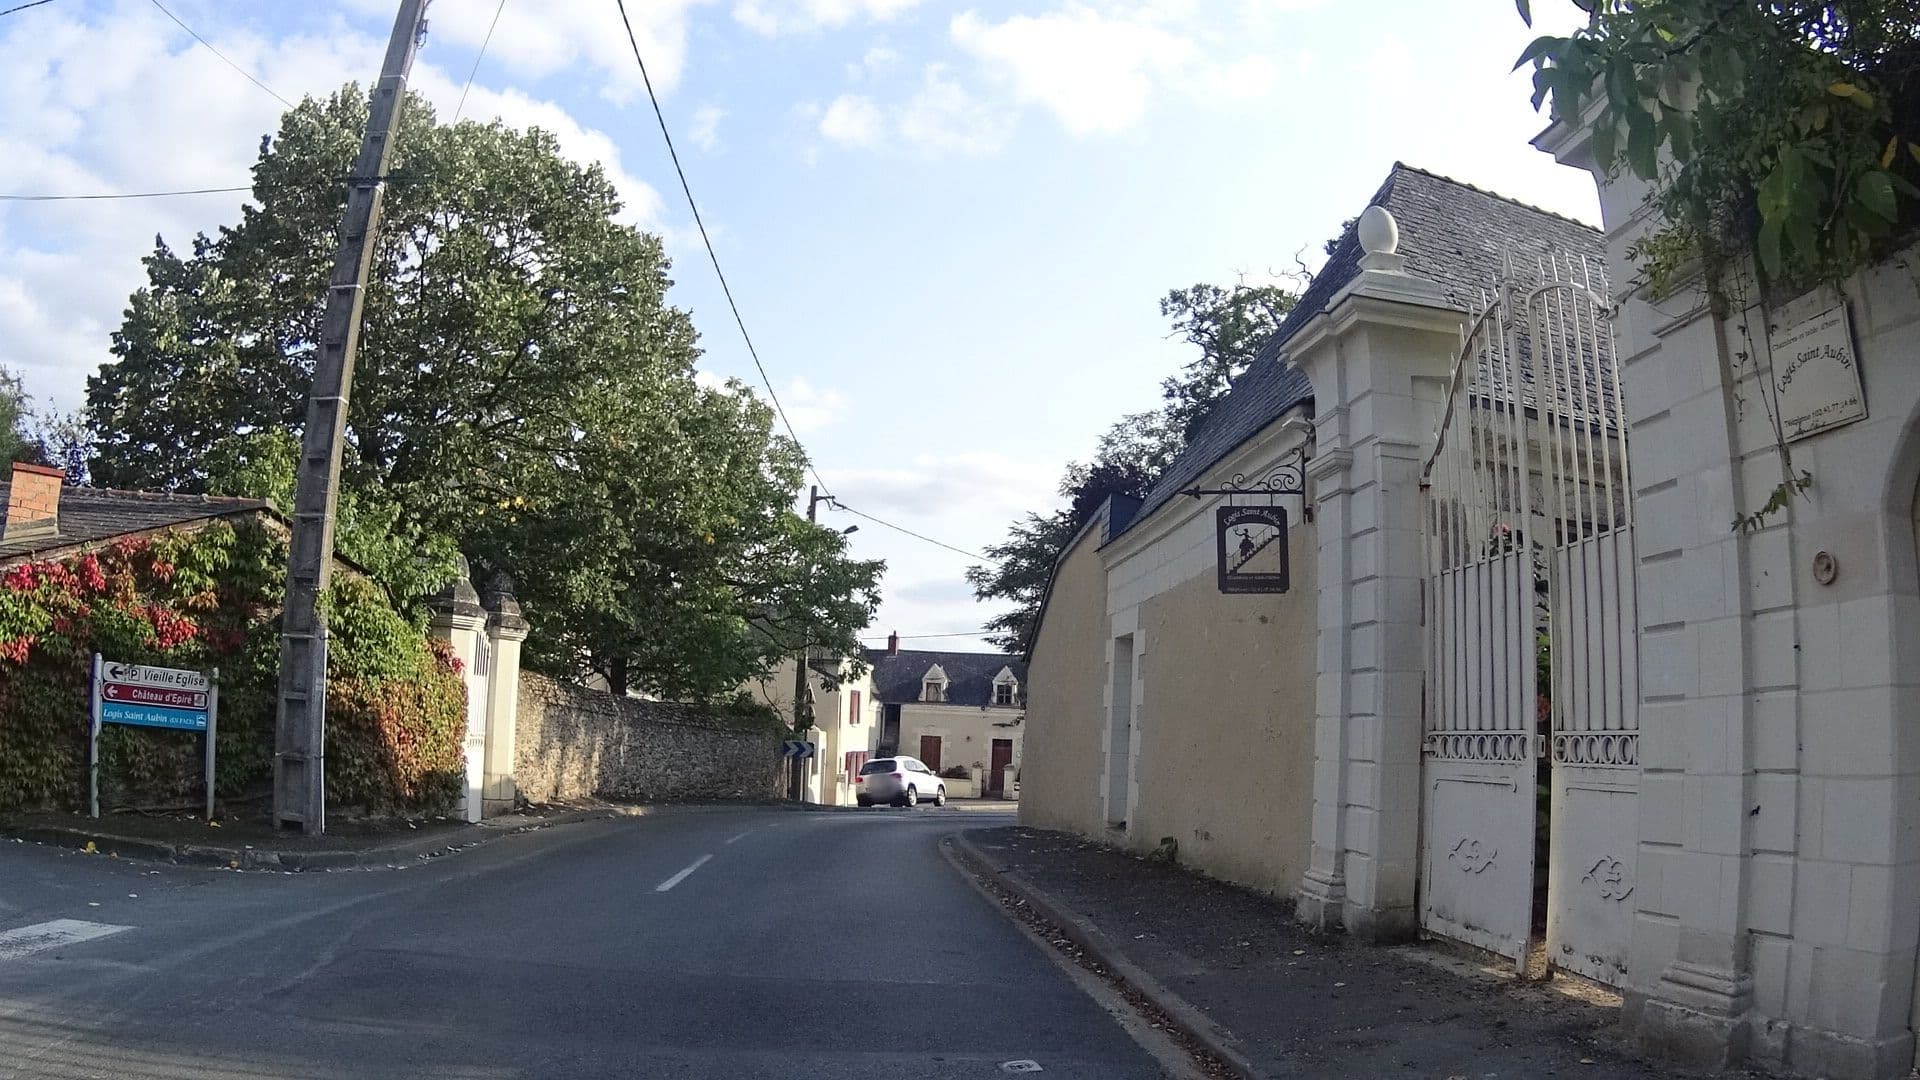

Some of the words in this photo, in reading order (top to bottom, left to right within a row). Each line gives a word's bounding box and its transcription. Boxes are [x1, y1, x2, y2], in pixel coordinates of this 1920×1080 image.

[1777, 361, 1796, 394] Logis
[1797, 346, 1819, 368] Saint
[1819, 344, 1851, 369] Aubin
[1224, 510, 1240, 526] Logis
[1240, 508, 1260, 516] Saint
[130, 670, 137, 679] P
[144, 670, 173, 683] Vieille
[175, 673, 205, 687] Eglise
[132, 689, 163, 702] Château
[103, 708, 123, 719] Logis
[123, 710, 144, 721] Saint
[144, 713, 168, 723] Aubin
